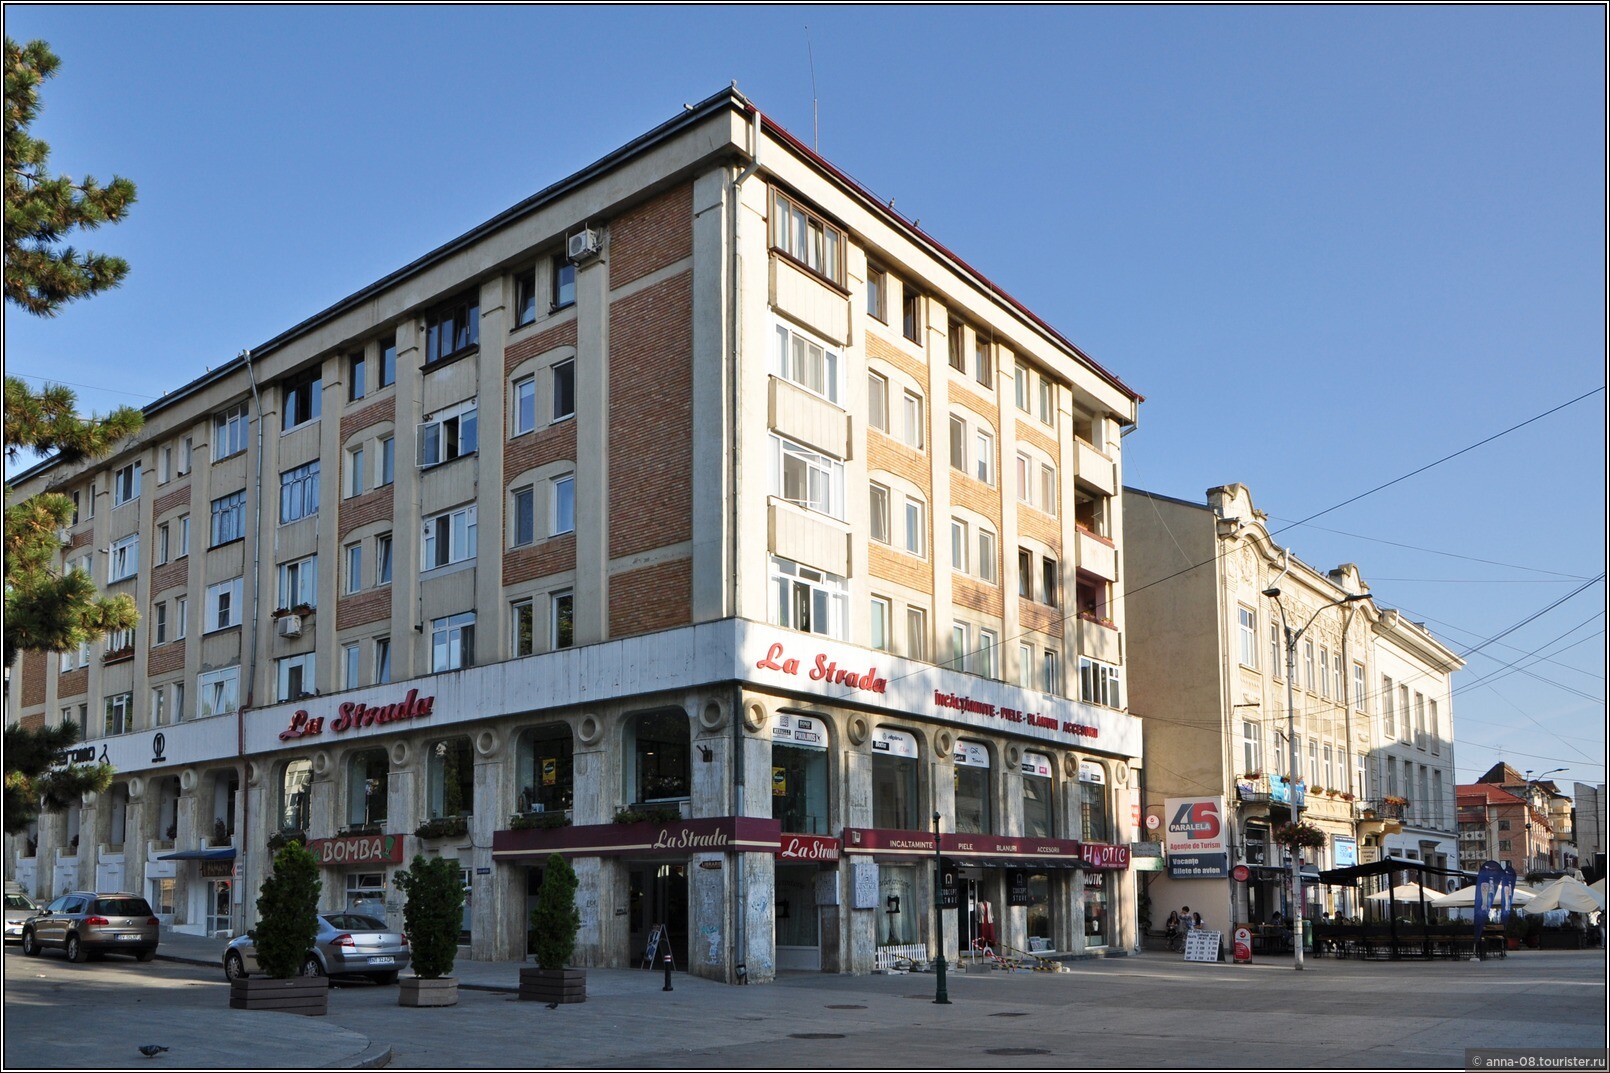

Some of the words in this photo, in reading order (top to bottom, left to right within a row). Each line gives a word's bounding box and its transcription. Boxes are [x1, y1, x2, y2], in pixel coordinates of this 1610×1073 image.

[757, 642, 800, 675] La
[809, 653, 888, 694] Strada
[279, 709, 325, 741] La
[330, 688, 435, 732] Strada
[1001, 707, 1023, 723] PIELE
[1170, 823, 1211, 832] PARALELA
[653, 829, 677, 849] La
[677, 827, 728, 849] Strada
[782, 838, 808, 858] La
[889, 840, 934, 849] INCALTAMINTE
[958, 843, 974, 851] PIELE
[996, 844, 1018, 852] BLANURI
[1037, 846, 1060, 854] ACCESORII
